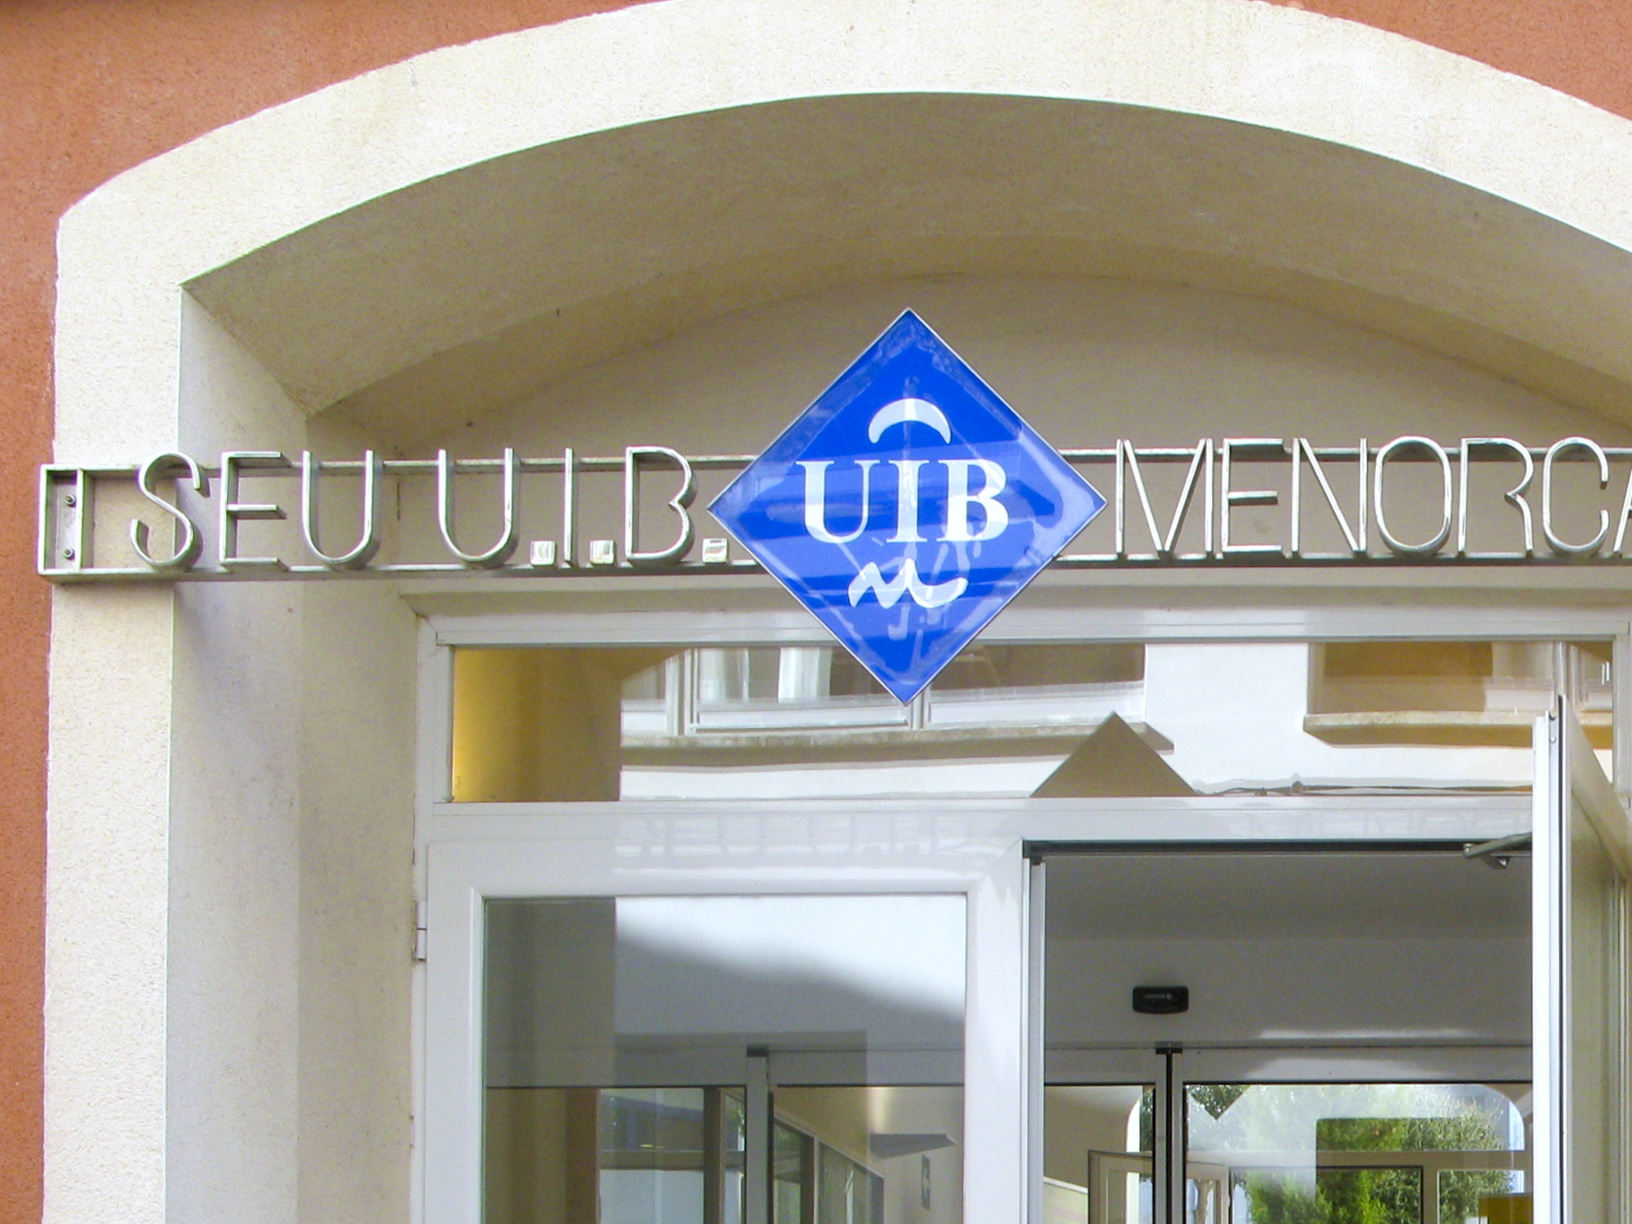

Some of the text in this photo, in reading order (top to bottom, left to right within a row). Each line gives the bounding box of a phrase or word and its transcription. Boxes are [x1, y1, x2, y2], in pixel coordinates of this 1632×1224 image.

[130, 449, 384, 570] SEU
[437, 445, 730, 569] U.I.B.
[795, 458, 1009, 544] UIB
